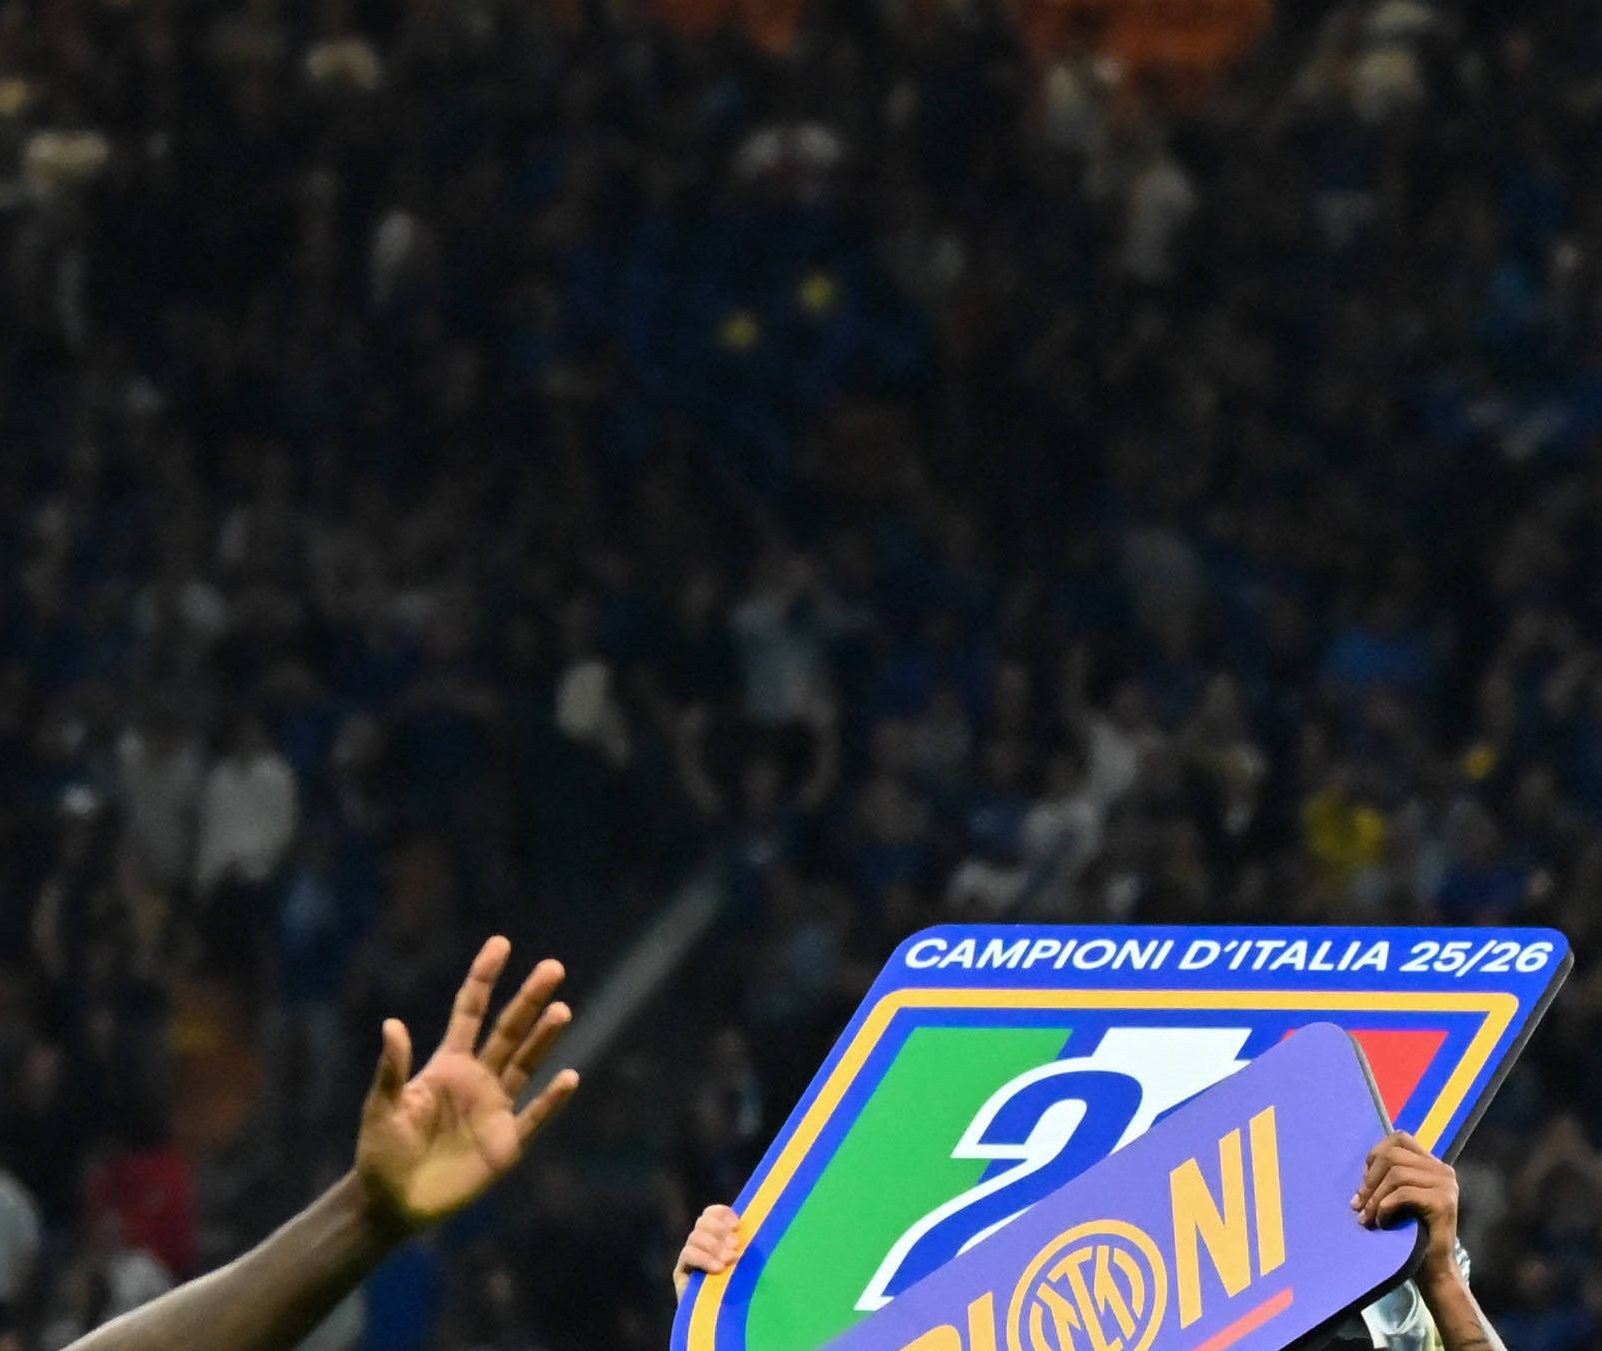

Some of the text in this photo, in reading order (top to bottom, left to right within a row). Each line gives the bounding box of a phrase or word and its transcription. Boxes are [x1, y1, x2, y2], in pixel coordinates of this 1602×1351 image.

[904, 936, 1555, 977] CAMPIONI D'ITALIA 25/26
